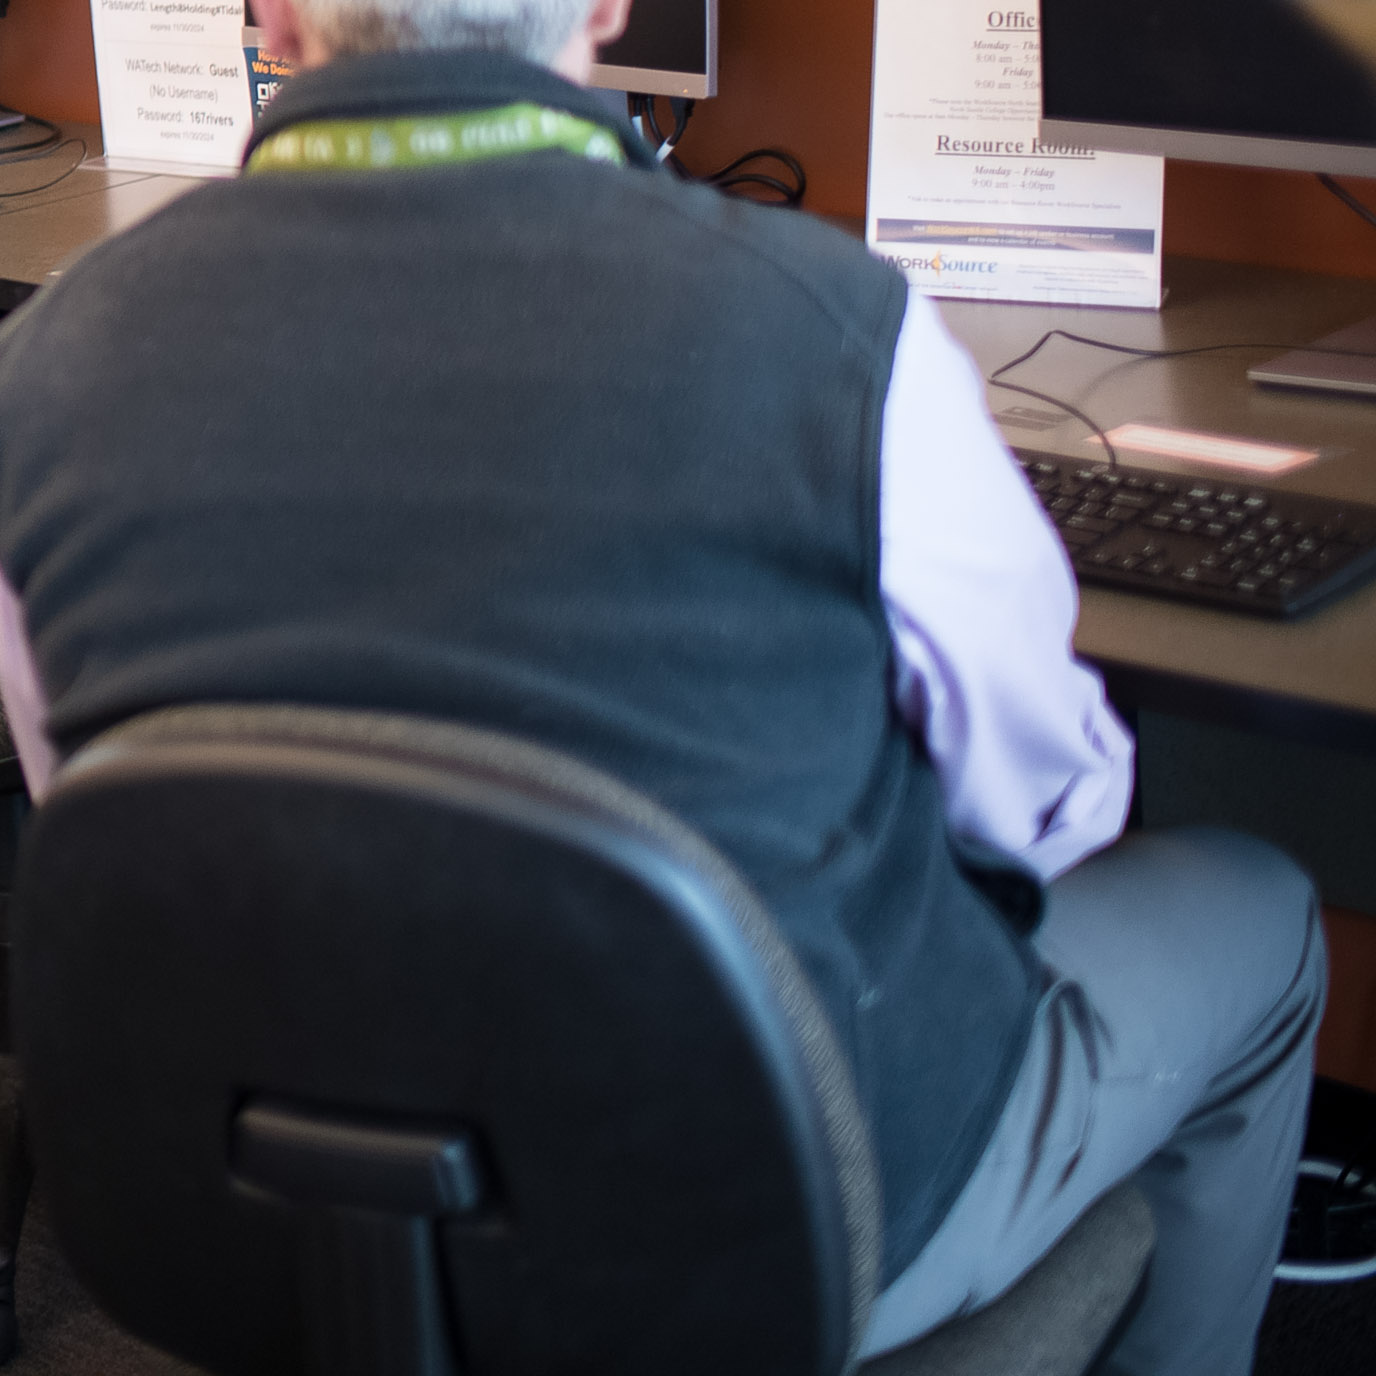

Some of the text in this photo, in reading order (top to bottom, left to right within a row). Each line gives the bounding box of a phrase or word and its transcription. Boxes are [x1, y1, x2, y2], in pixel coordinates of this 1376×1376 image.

[973, 40, 1011, 52] Monday
[998, 56, 1013, 64] am
[125, 58, 239, 79] WATech Network: Guest
[252, 61, 269, 74] We
[1002, 67, 1034, 78] Friday
[998, 82, 1012, 90] am
[149, 85, 219, 103] (No Username)
[137, 106, 234, 127] Password: 167rivers
[936, 134, 1025, 155] Resource
[974, 165, 1056, 179] Monday Friday
[994, 181, 1009, 189] am
